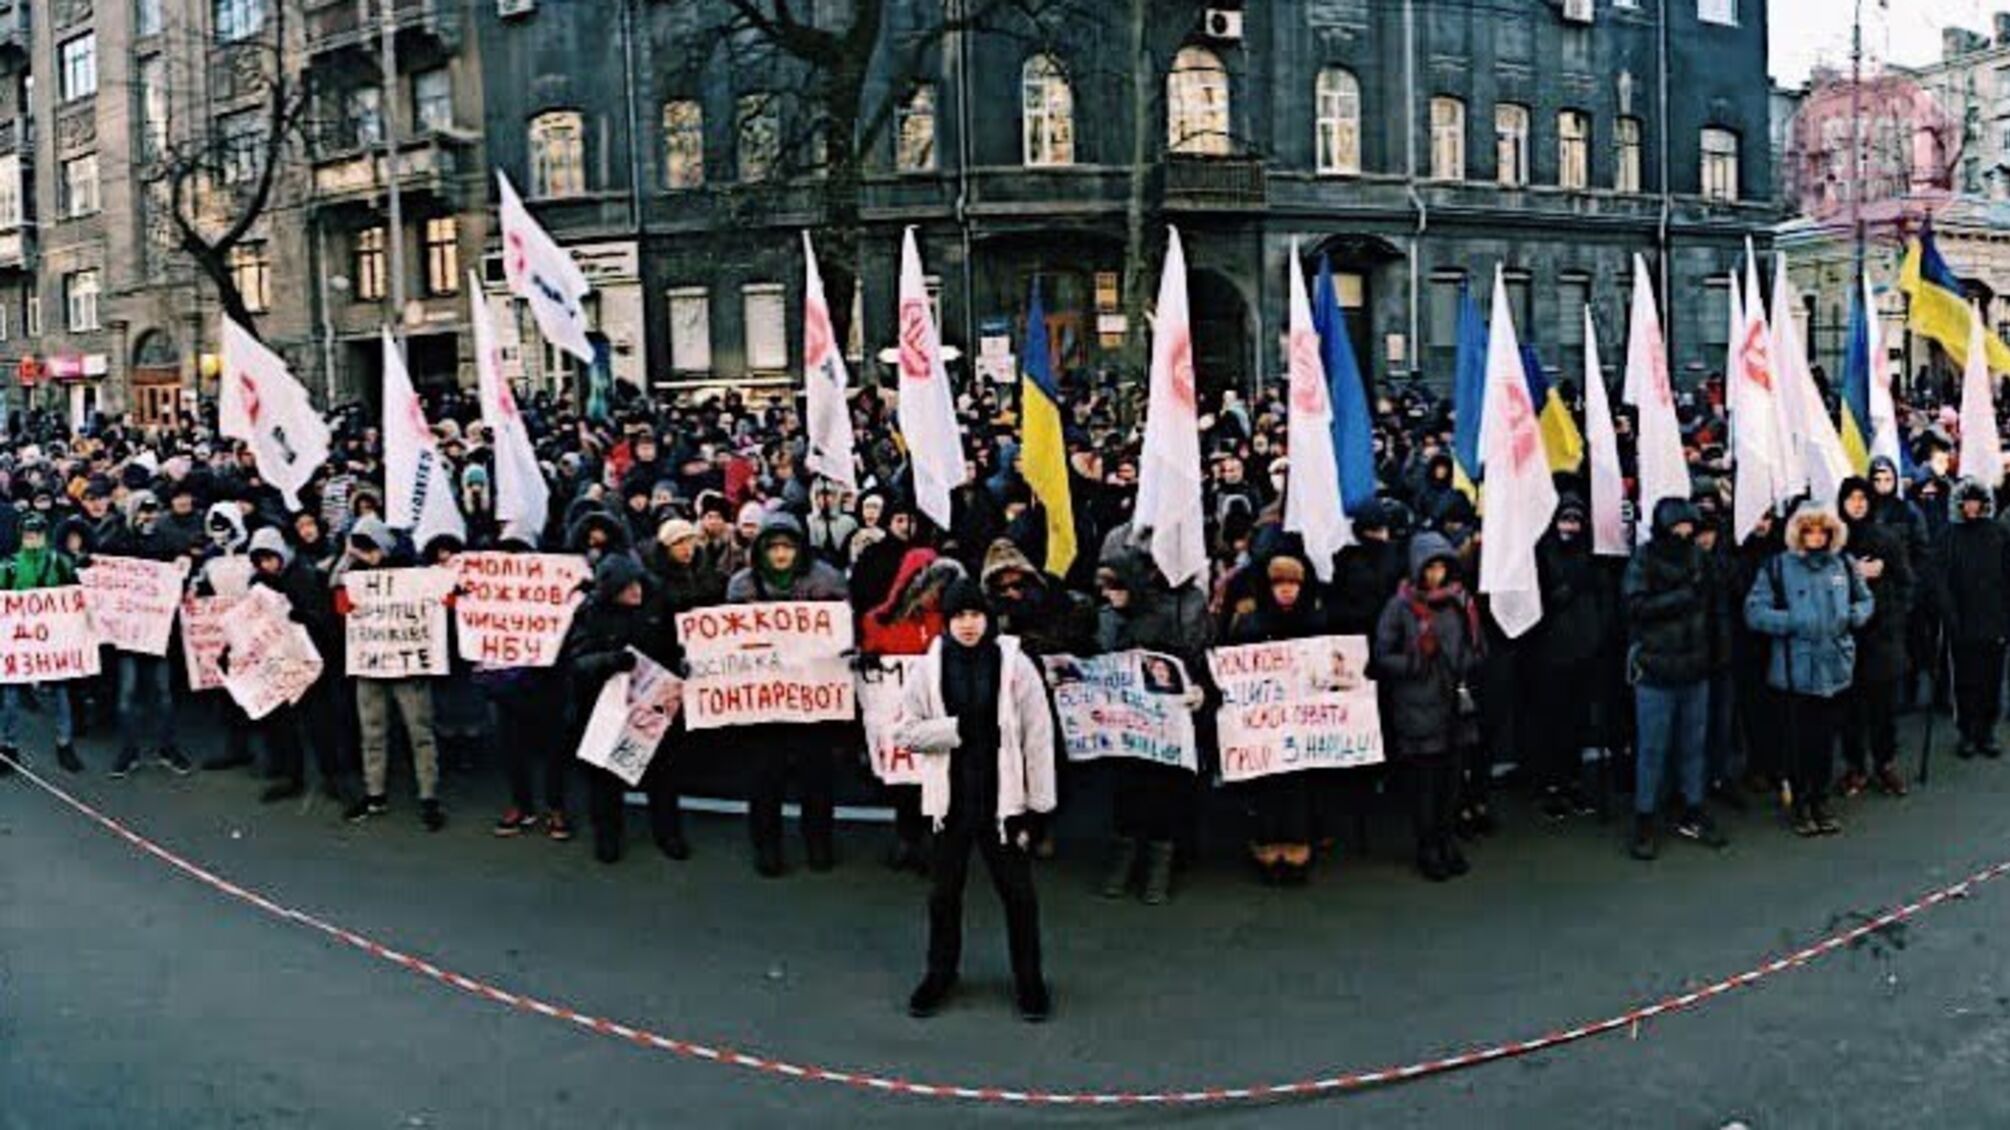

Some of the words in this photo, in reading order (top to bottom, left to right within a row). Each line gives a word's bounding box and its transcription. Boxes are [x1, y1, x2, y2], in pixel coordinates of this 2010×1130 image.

[462, 580, 574, 605] РОЖКОВ
[13, 623, 48, 641] ДО
[682, 606, 833, 640] РОЖКОВА
[482, 635, 541, 662] НБУ
[698, 680, 849, 716] ГОНТАРЕВОЇ
